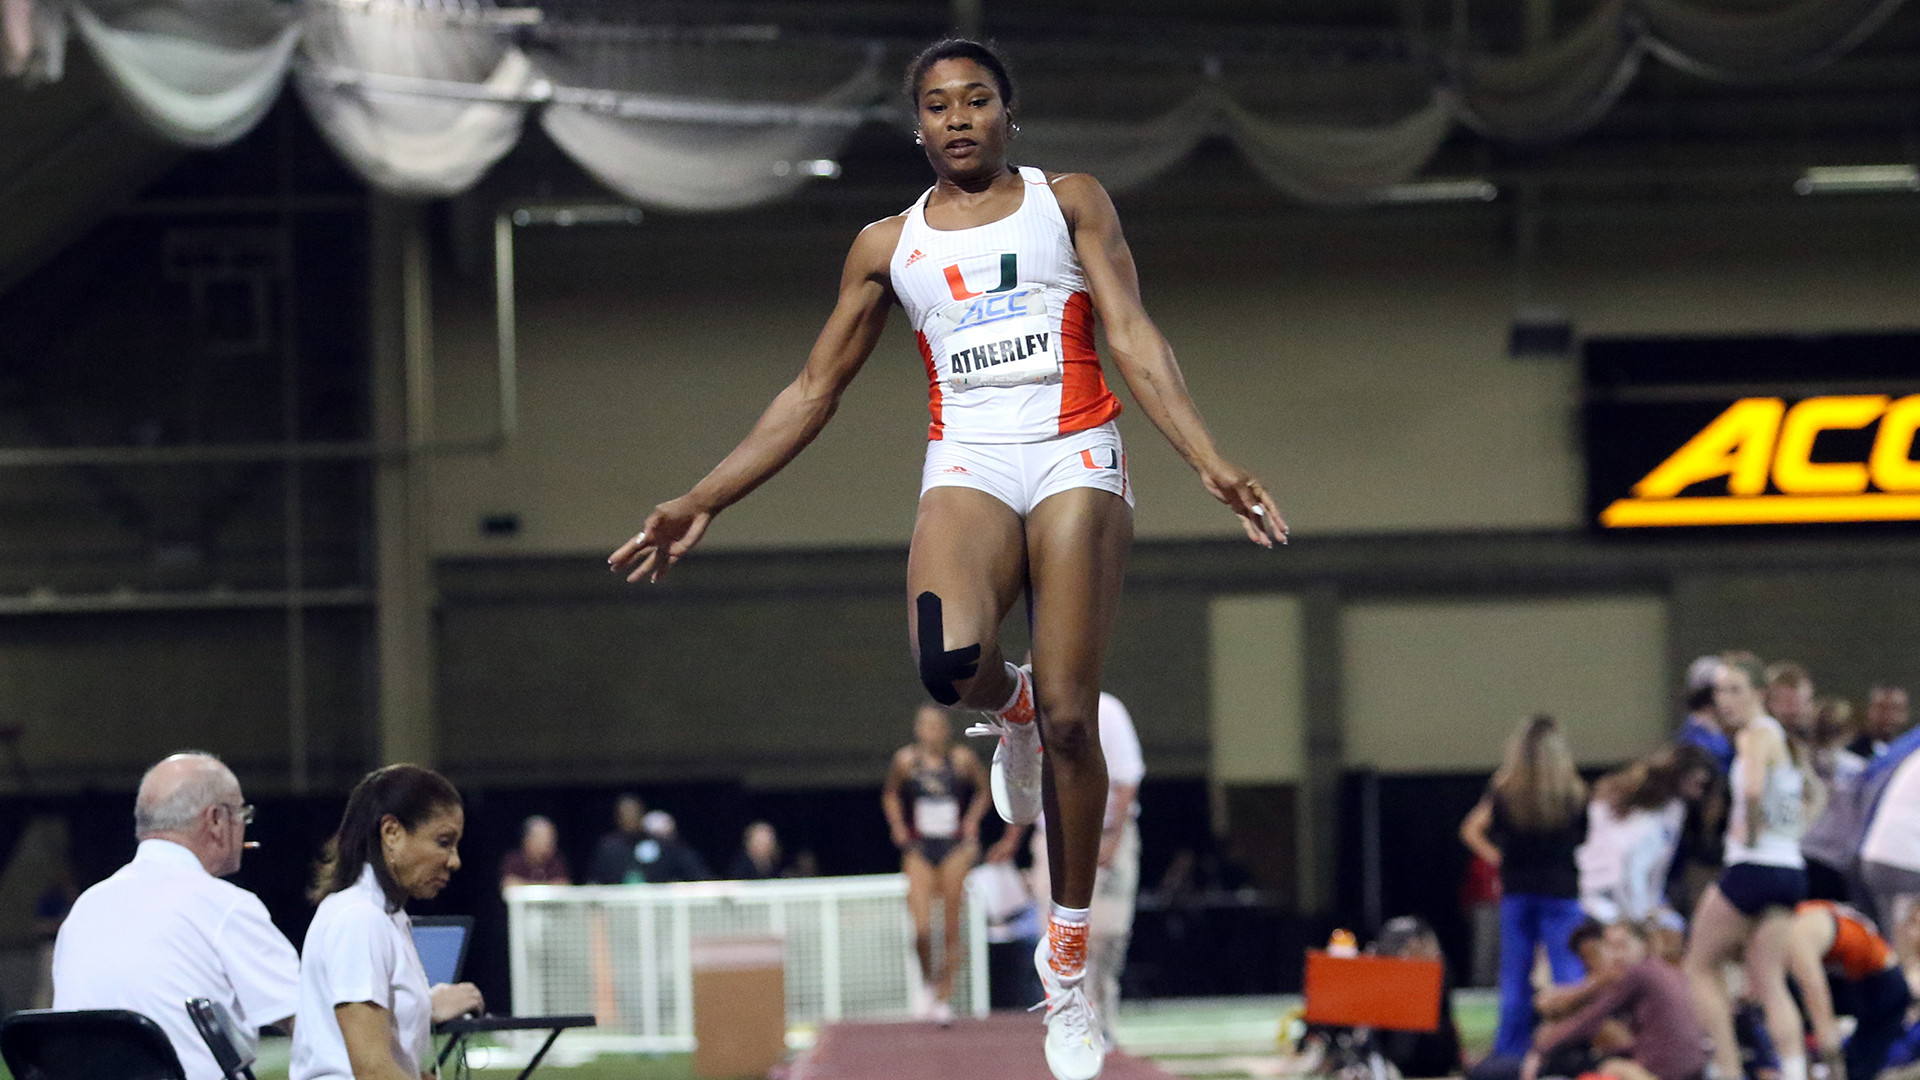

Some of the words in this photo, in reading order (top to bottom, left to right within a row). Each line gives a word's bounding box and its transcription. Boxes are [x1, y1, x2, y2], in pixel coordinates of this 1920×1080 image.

[943, 253, 1018, 301] U
[960, 291, 1029, 326] ACC
[951, 332, 1050, 375] ATHERLEY
